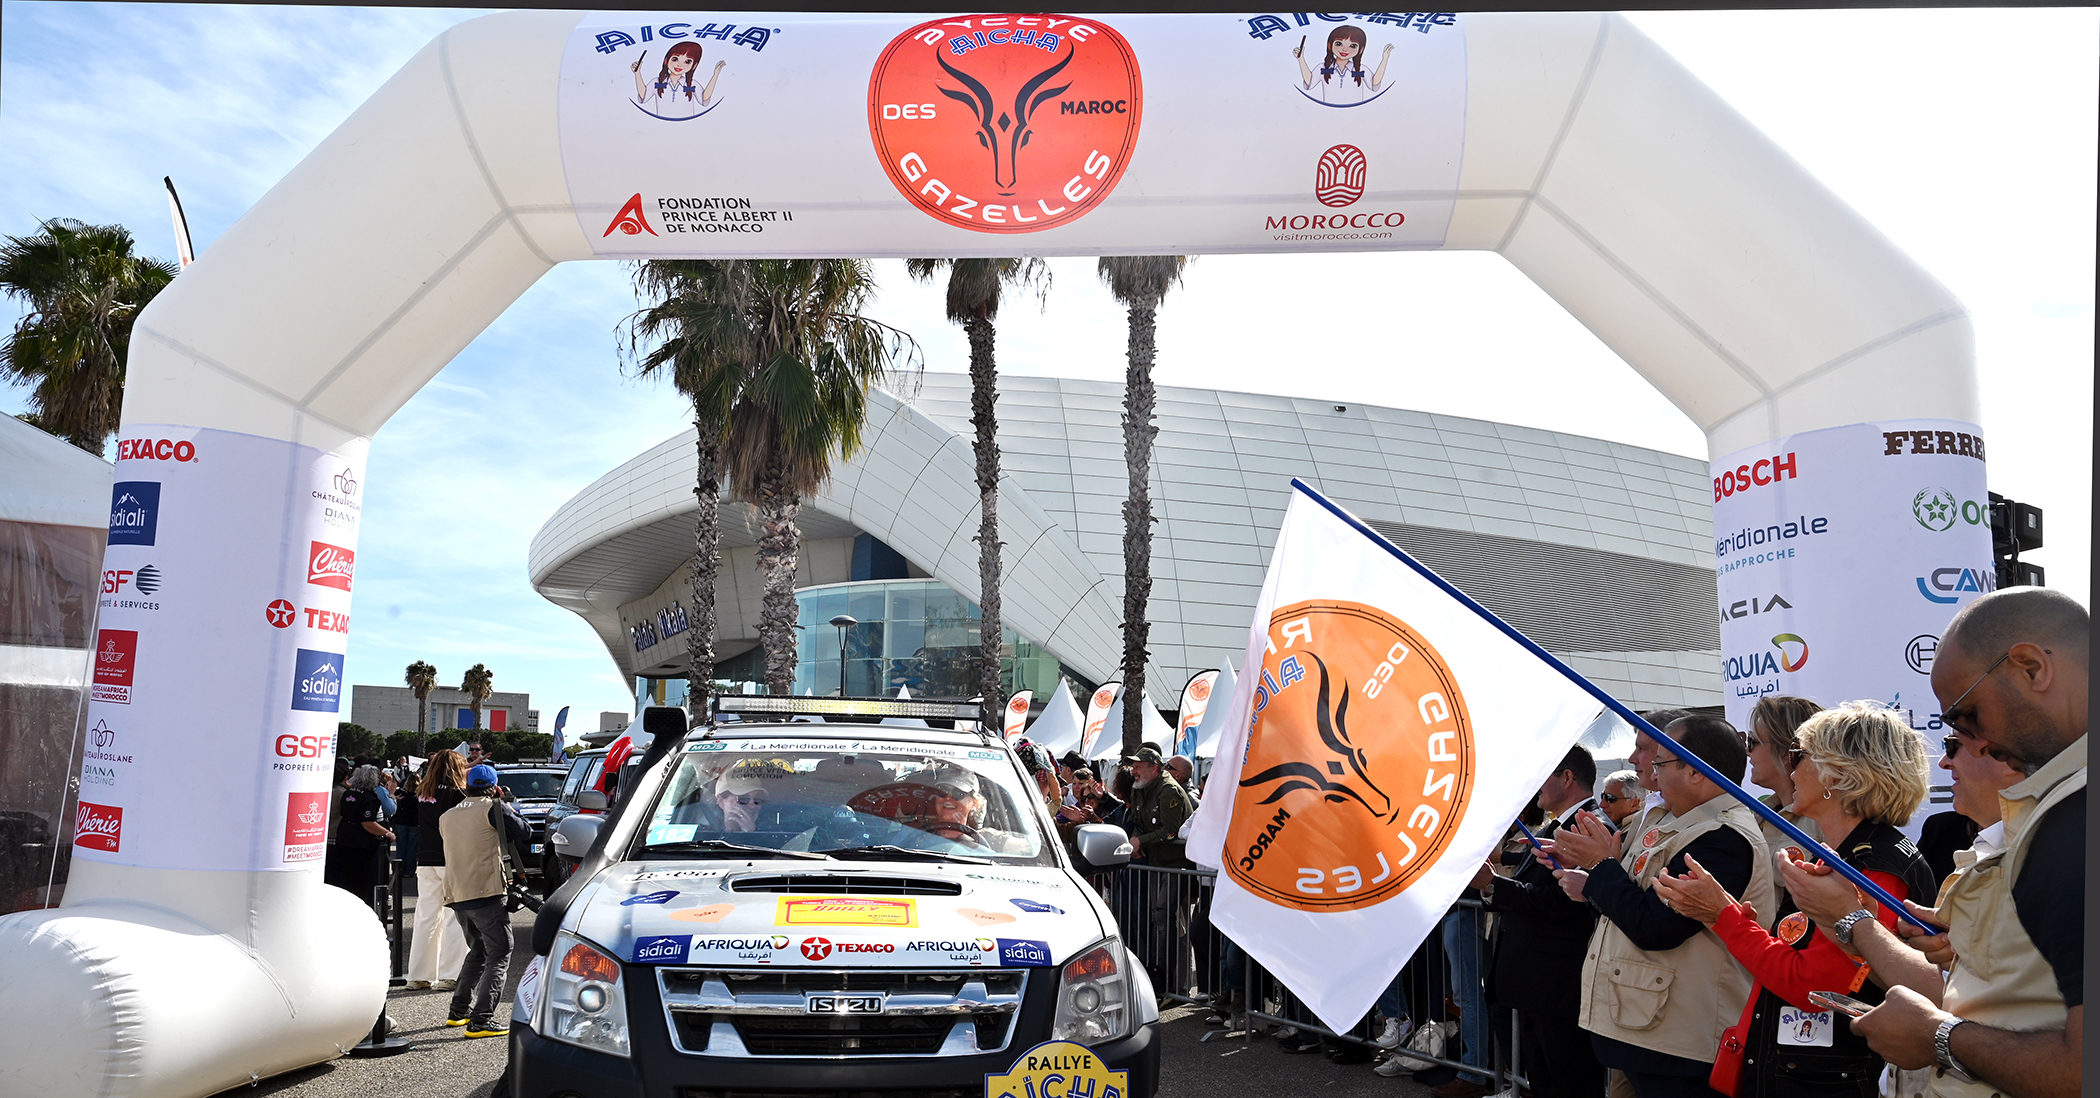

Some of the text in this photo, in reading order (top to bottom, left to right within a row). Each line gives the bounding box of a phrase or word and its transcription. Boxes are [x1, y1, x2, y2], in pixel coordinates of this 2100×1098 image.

[595, 23, 771, 54] AICHA
[949, 28, 1060, 56] AICHA
[883, 104, 936, 120] DES
[1061, 100, 1127, 115] MAROC
[900, 150, 1111, 223] GAZELLES
[658, 198, 751, 210] FONDATION
[662, 211, 793, 222] PRINCE ALBERT II
[1265, 212, 1405, 231] MOROCCO
[666, 223, 763, 234] DE MONACO
[1273, 231, 1393, 241] visitmorocco.com
[117, 438, 195, 463] TEXACO
[1882, 430, 1986, 463] FERRE
[1713, 452, 1798, 504] BOSCH
[1725, 548, 1796, 573] RAPPROCHE
[120, 600, 160, 611] SERVICES
[630, 619, 657, 652] Palais
[275, 734, 331, 758] GSF
[689, 743, 727, 752] MDJS
[769, 741, 847, 751] Méridionale
[879, 745, 956, 757] Méridionale
[968, 751, 1003, 761] MDJS
[100, 752, 133, 764] ROSLANE
[84, 764, 115, 778] DIANA
[273, 762, 313, 772] PROPRETÉ
[77, 806, 120, 834] Chérie
[656, 828, 691, 842] 182
[695, 939, 772, 950] AFRIQUIA
[836, 943, 895, 953] TEXACO
[906, 941, 981, 951] AFRIQUIA
[812, 999, 879, 1012] ISUZU
[1028, 1055, 1092, 1071] RALLYE
